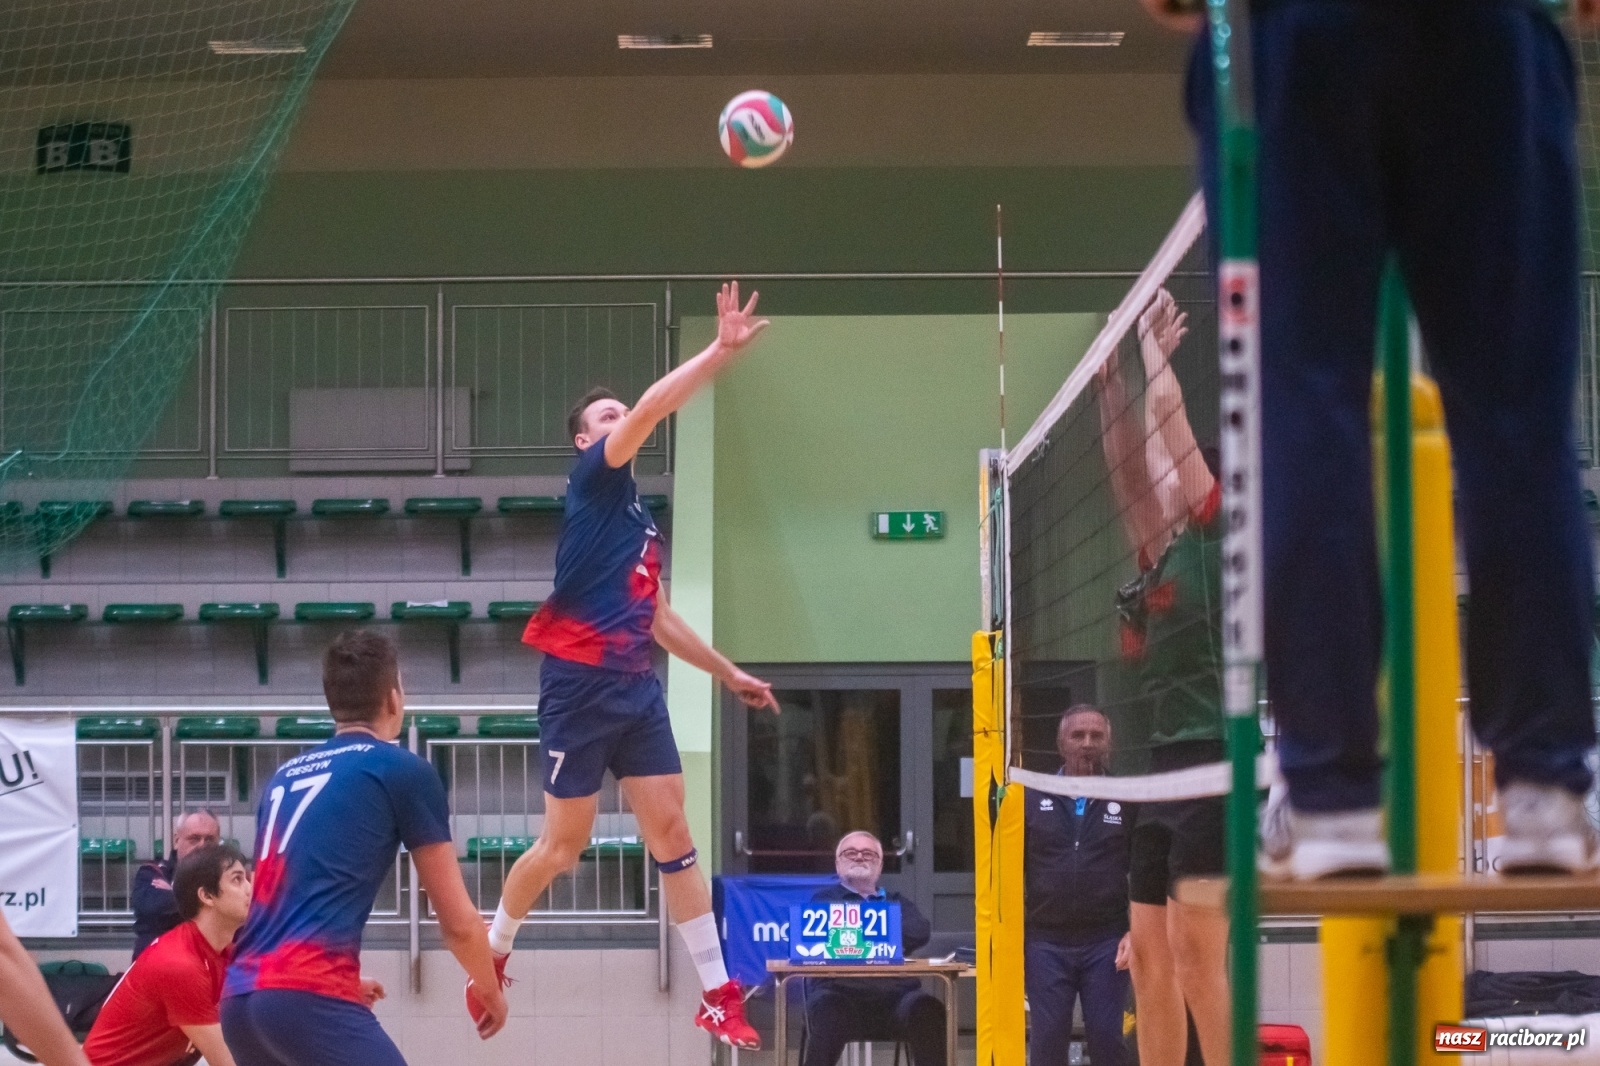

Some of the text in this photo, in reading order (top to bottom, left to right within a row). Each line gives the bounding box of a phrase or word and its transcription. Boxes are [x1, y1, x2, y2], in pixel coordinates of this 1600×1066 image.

[89, 139, 118, 167] B
[0, 750, 38, 787] U!
[286, 759, 331, 778] CIESZYN
[548, 750, 566, 785] 7
[261, 772, 332, 862] 17
[803, 909, 828, 937] 22
[864, 909, 887, 936] 21
